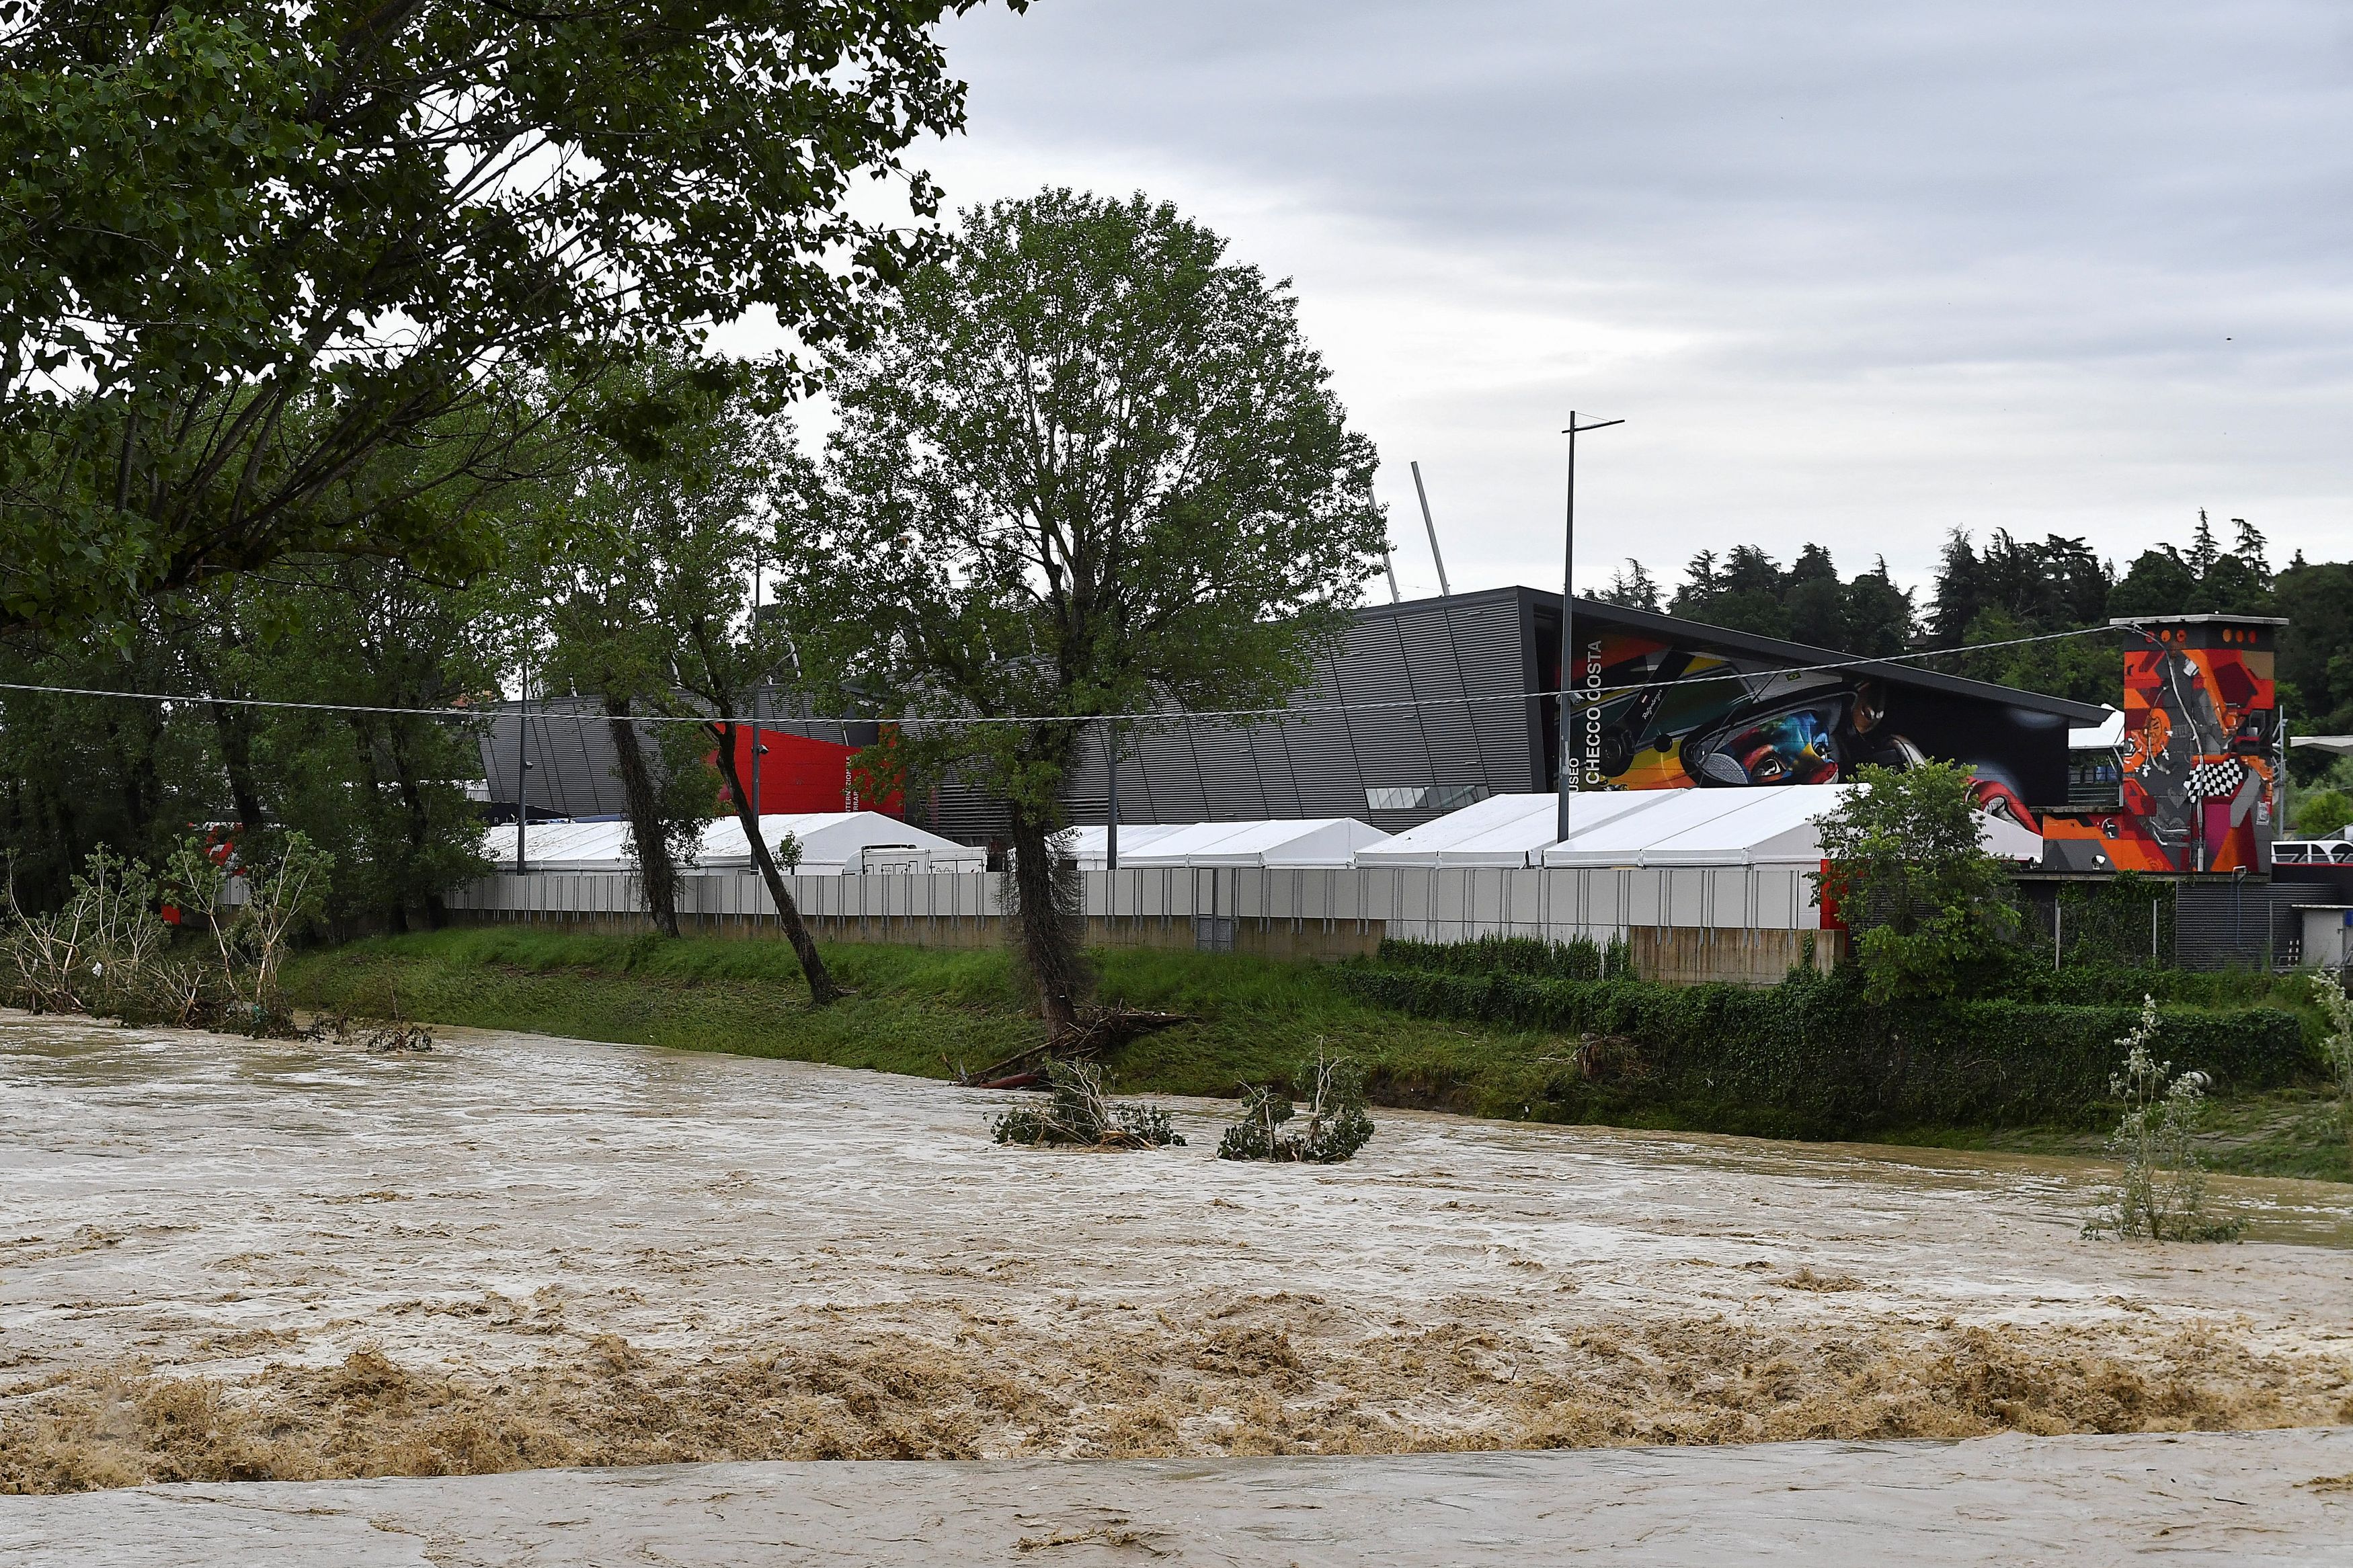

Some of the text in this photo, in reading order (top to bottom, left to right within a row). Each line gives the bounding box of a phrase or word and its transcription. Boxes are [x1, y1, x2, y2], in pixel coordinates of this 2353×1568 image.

[1585, 640, 1601, 784] CHECCO COSTA
[1568, 757, 1579, 792] USEO
